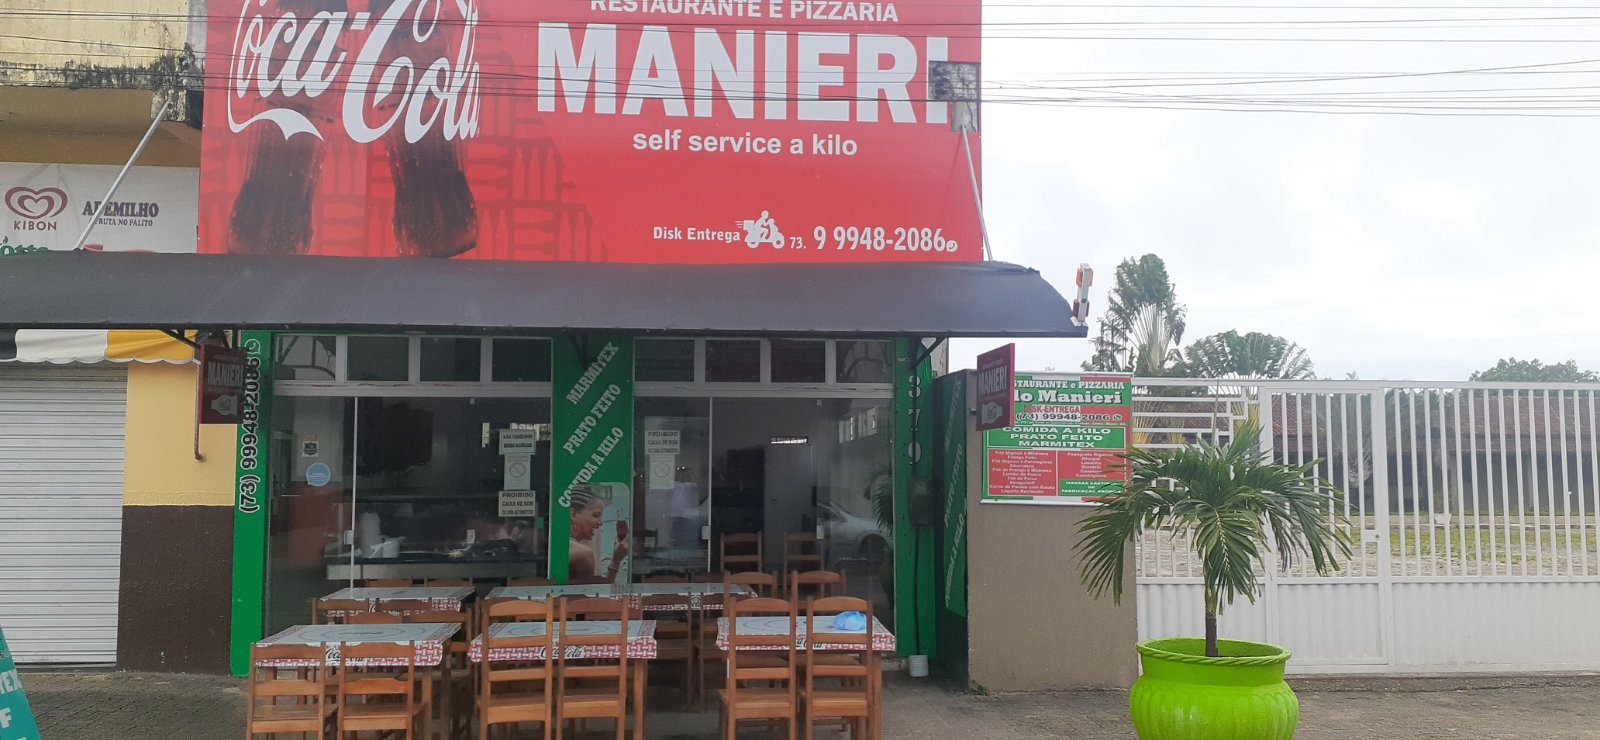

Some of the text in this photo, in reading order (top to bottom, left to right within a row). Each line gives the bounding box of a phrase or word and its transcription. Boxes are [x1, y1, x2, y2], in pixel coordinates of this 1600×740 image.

[590, 0, 898, 22] RESTAURANTE E PIZZARIA
[228, 0, 480, 144] Coca-Cola
[537, 22, 948, 124] MANIERI
[633, 129, 858, 156] self service a kilo
[13, 220, 57, 231] KIBON
[119, 218, 128, 226] NO
[129, 219, 154, 227] PALITO
[653, 225, 946, 252] Disk Entrega 73. 9 9948-2086
[566, 341, 619, 405] MARMITEX
[979, 365, 1007, 395] MANIERI
[1014, 380, 1068, 388] TAURANTE
[1078, 381, 1125, 389] PIZZARIA
[1038, 390, 1122, 404] Manieri
[563, 384, 621, 455] PRATO FEITO
[1042, 413, 1110, 421] 99948-2086
[591, 452, 605, 466] A
[602, 427, 624, 457] KILO
[239, 474, 260, 513] (73)
